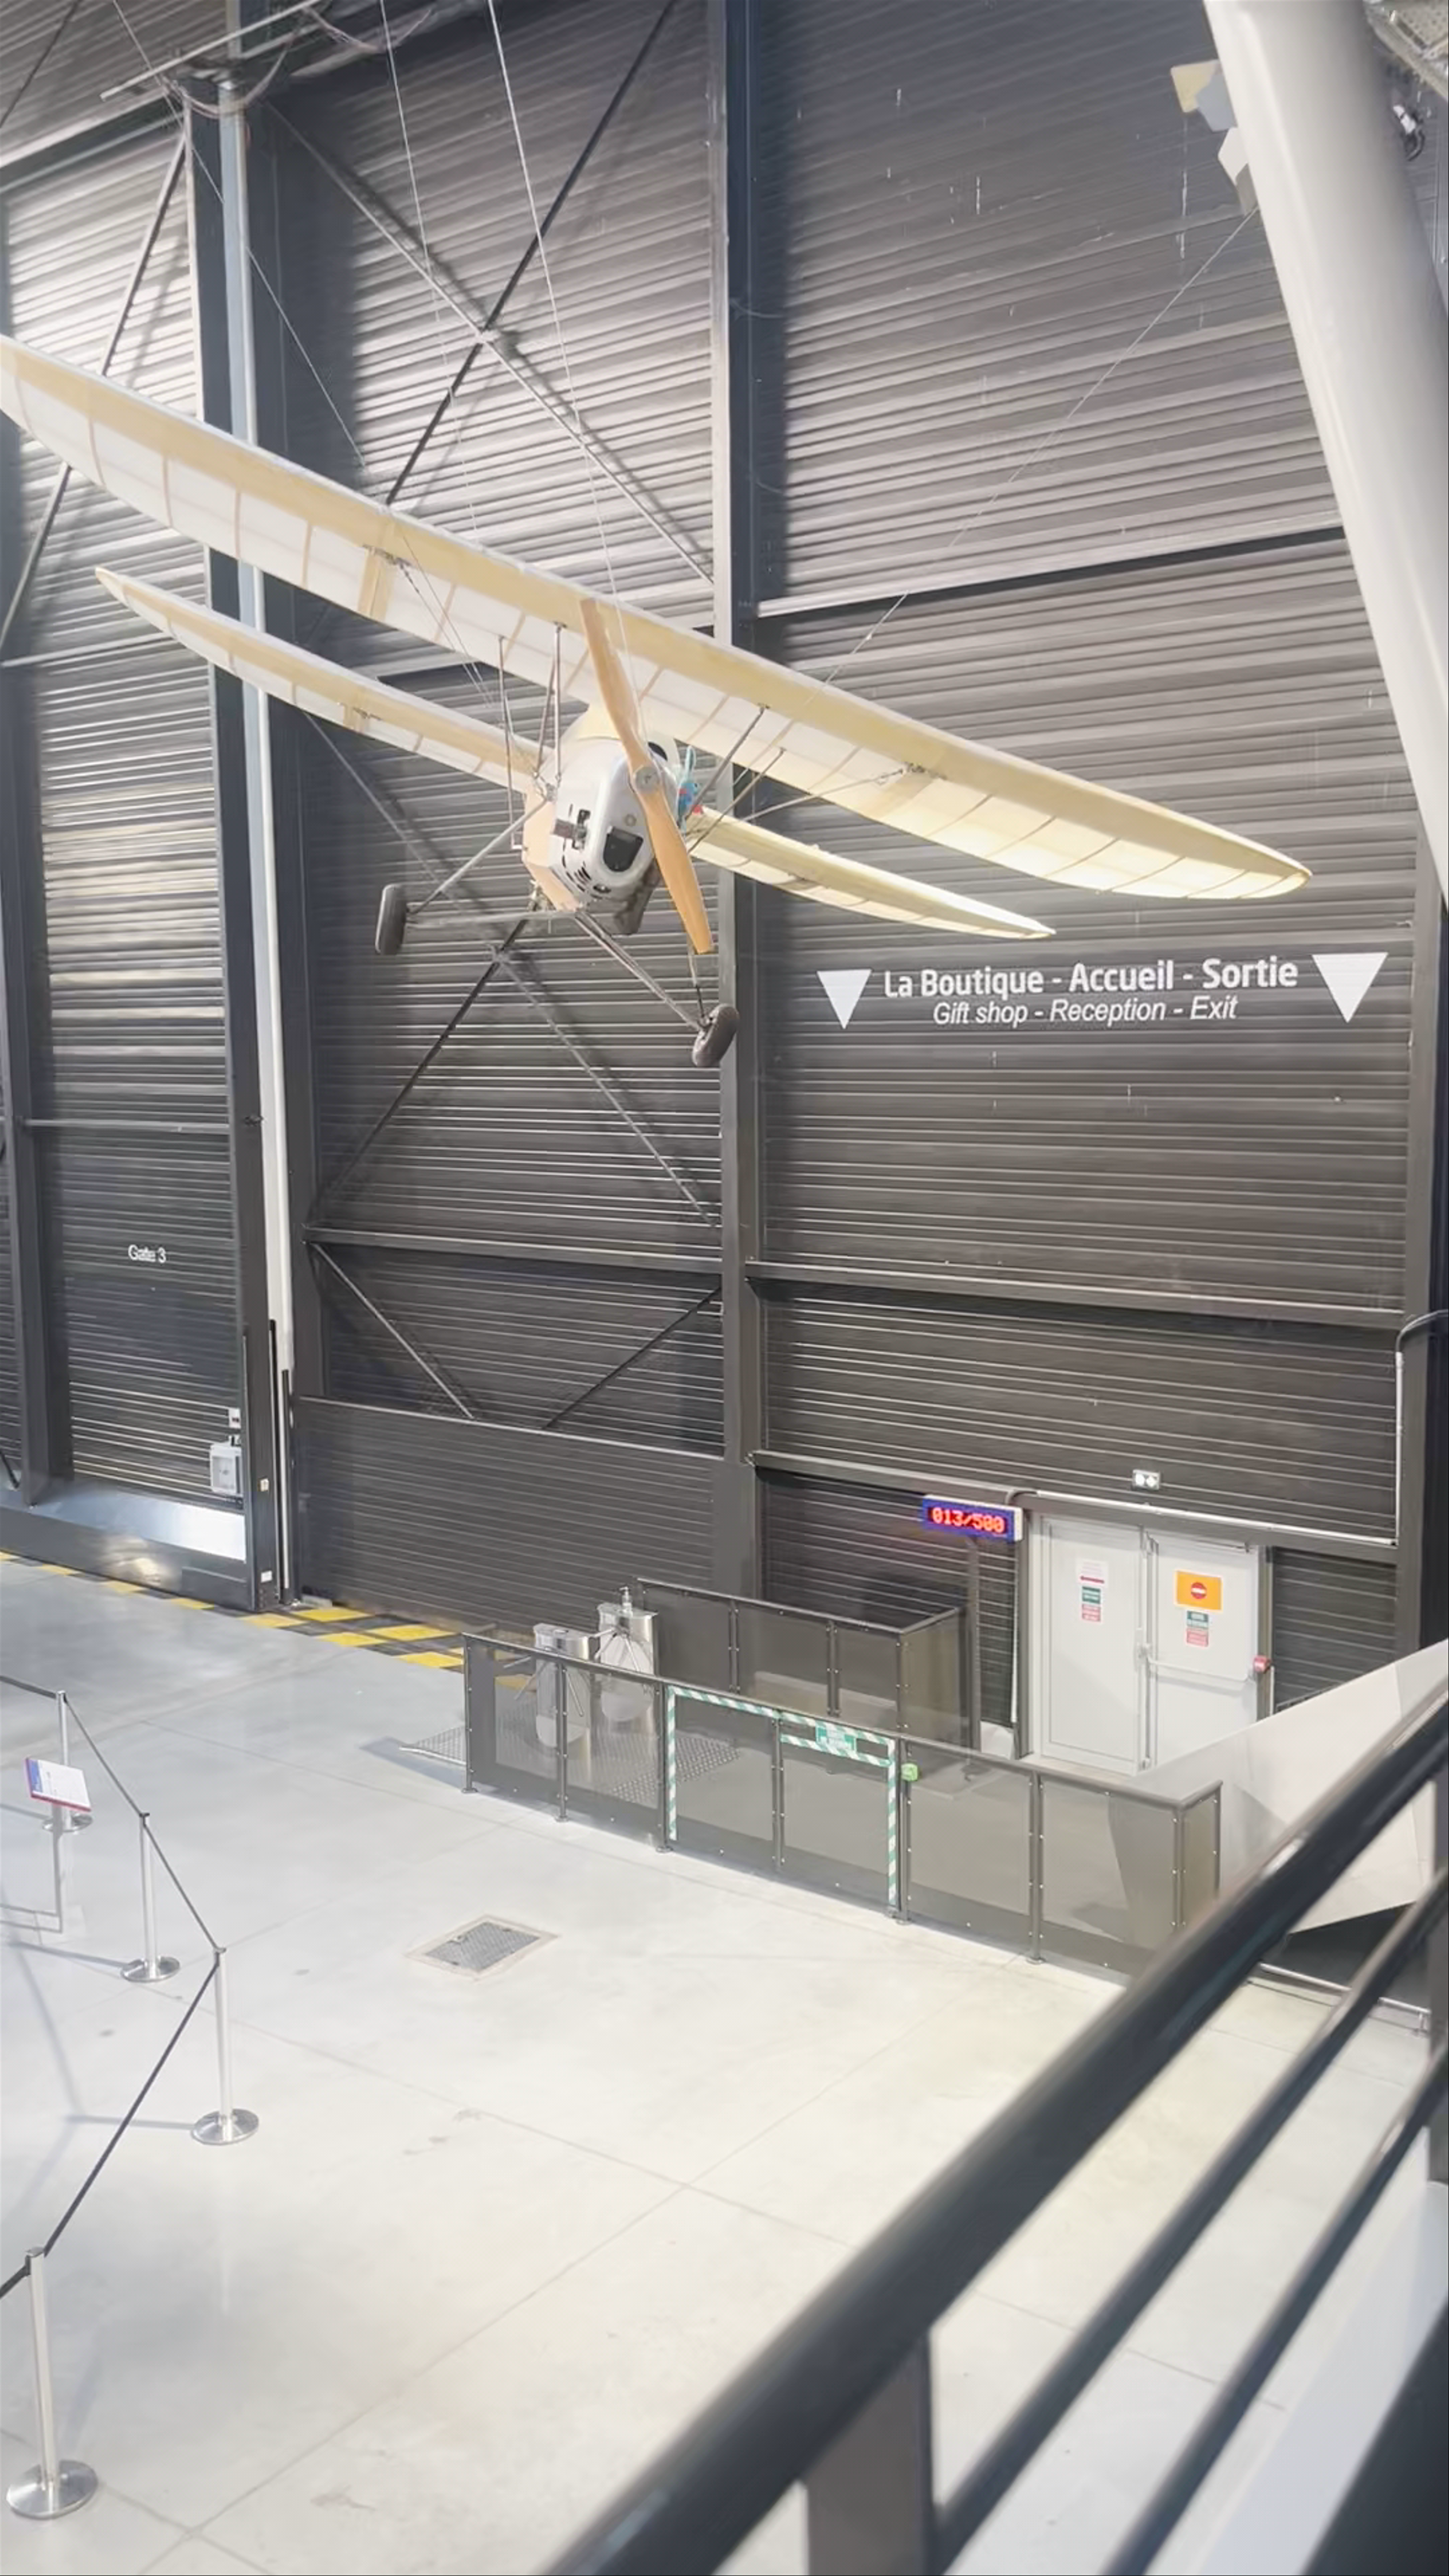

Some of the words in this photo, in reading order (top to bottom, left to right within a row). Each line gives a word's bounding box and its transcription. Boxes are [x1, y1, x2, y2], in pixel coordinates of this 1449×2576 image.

[884, 971, 912, 997] La
[921, 966, 1043, 1000] Boutique
[1069, 960, 1174, 992] Accueil
[1202, 955, 1298, 988] Sortie
[933, 1001, 970, 1025] Gift
[975, 1001, 1028, 1029] shop
[1050, 998, 1166, 1027] Reception
[1190, 995, 1239, 1020] Exit
[128, 1244, 156, 1262] Gate
[157, 1247, 166, 1263] 3
